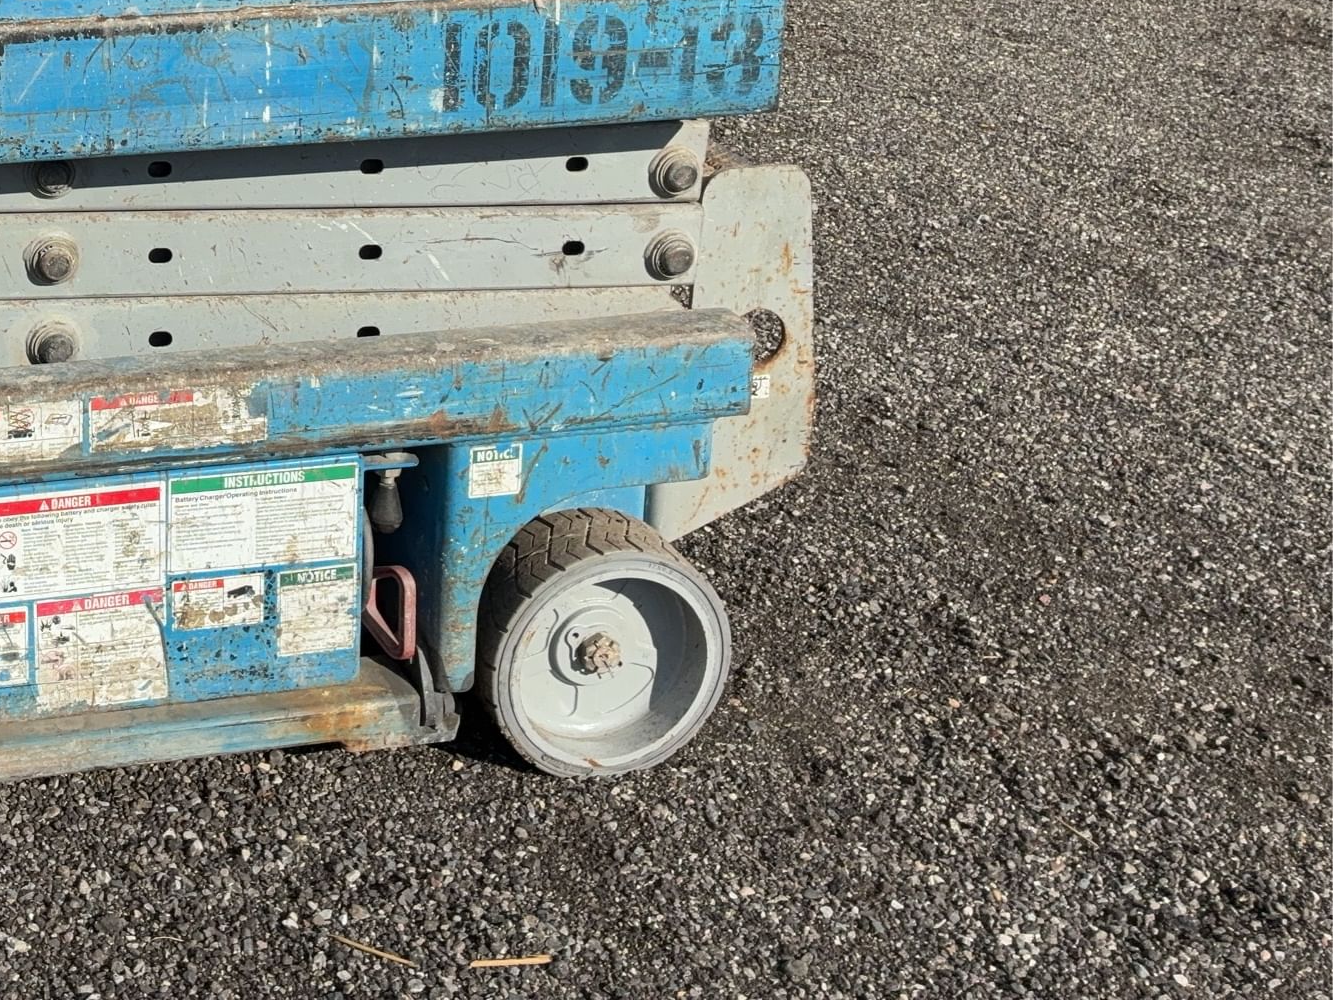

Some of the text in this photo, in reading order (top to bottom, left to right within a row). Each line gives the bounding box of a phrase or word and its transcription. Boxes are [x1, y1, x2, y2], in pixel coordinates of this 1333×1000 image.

[442, 12, 765, 112] 1019-13
[476, 448, 516, 462] NOTIC
[224, 470, 306, 489] INSTRUCTIONS
[175, 496, 199, 504] Battery
[226, 489, 259, 499] Operating
[259, 487, 298, 496] Instructions
[50, 496, 92, 510] DANGER
[60, 509, 83, 517] battery
[96, 505, 121, 514] charger
[4, 521, 23, 529] death
[31, 518, 55, 527] serious
[55, 516, 74, 525] injury
[297, 569, 337, 584] NOTICE
[188, 582, 218, 591] DANGER
[84, 594, 131, 611] DANGER
